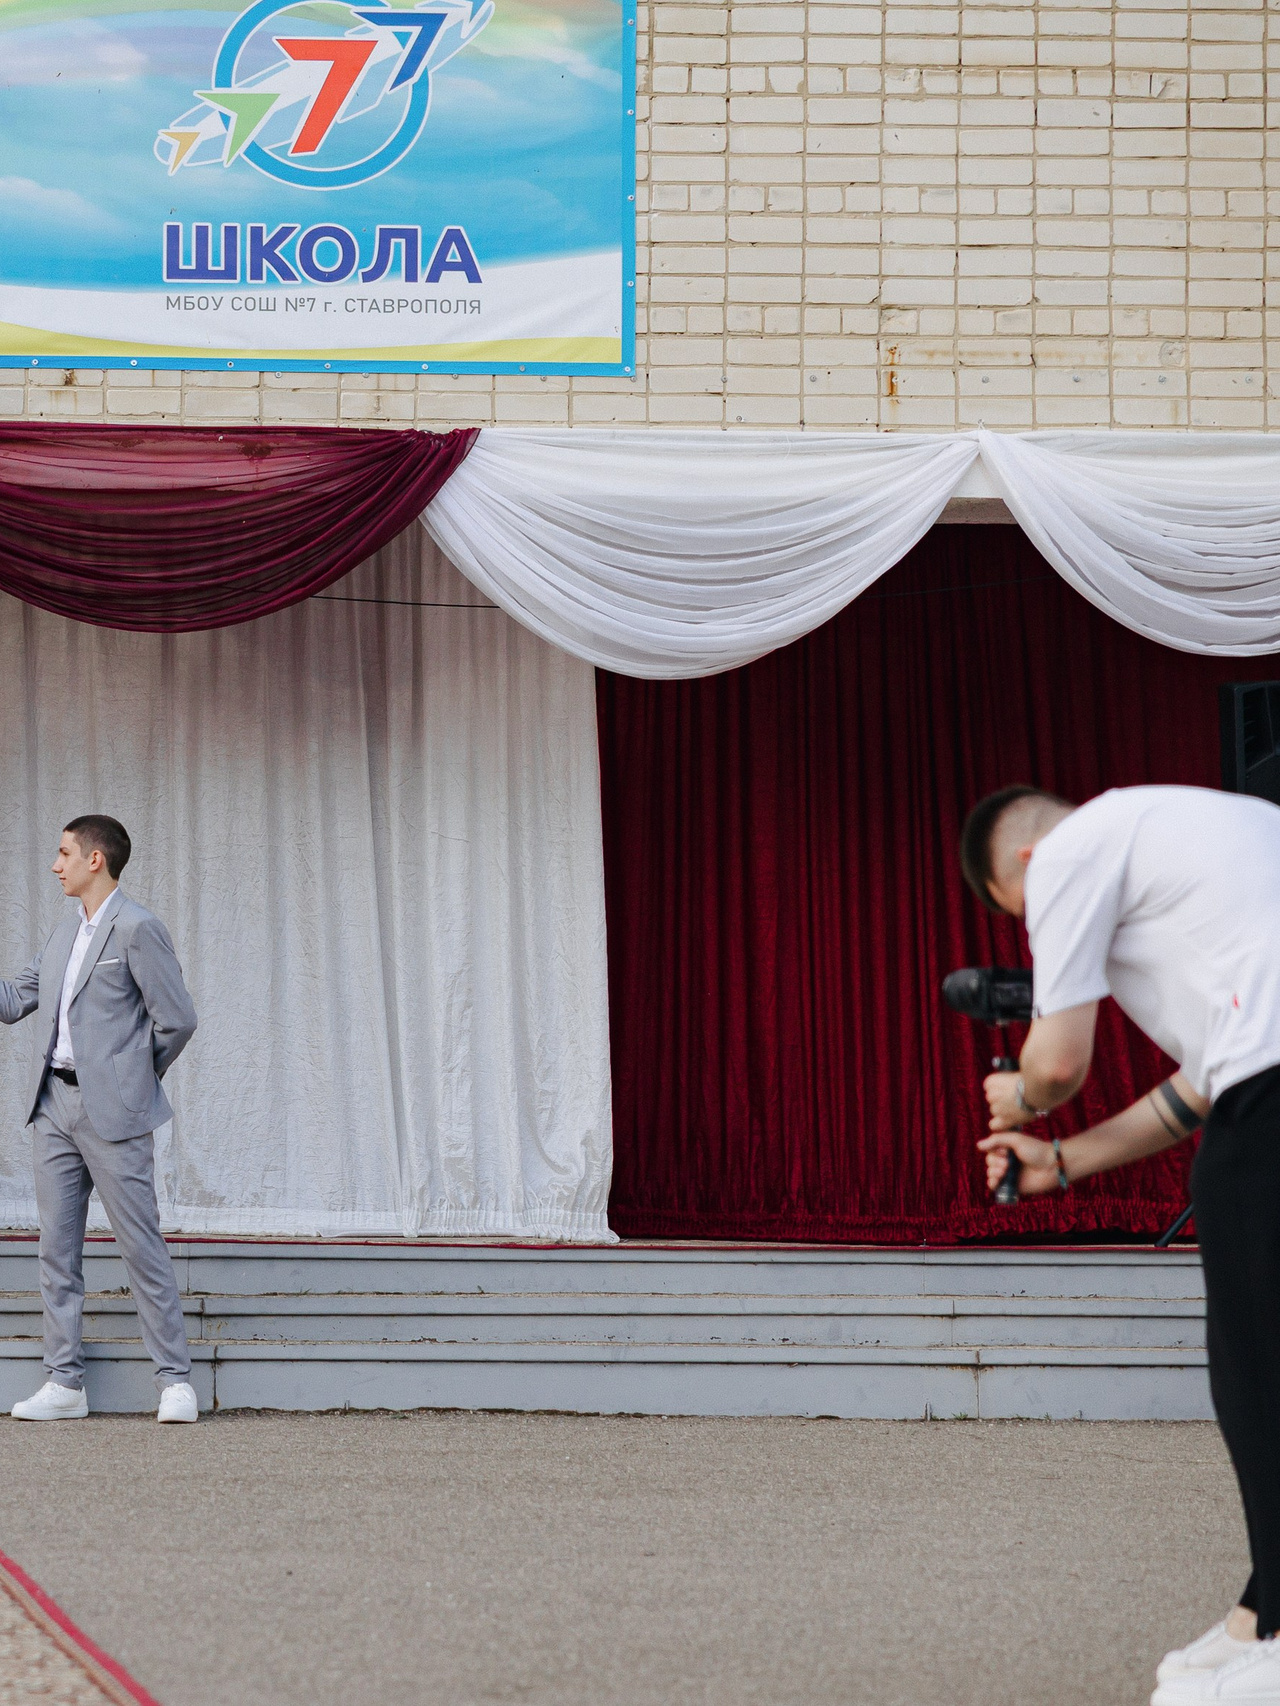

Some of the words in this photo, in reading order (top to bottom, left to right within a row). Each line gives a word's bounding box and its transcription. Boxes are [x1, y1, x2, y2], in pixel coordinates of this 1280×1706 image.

[164, 223, 484, 285] ШКОЛА
[166, 295, 224, 311] МБОУ
[231, 296, 276, 312] СОШ
[285, 297, 317, 312] №7
[324, 301, 337, 313] г.
[344, 297, 481, 314] СТАВРОПОЛЯ
